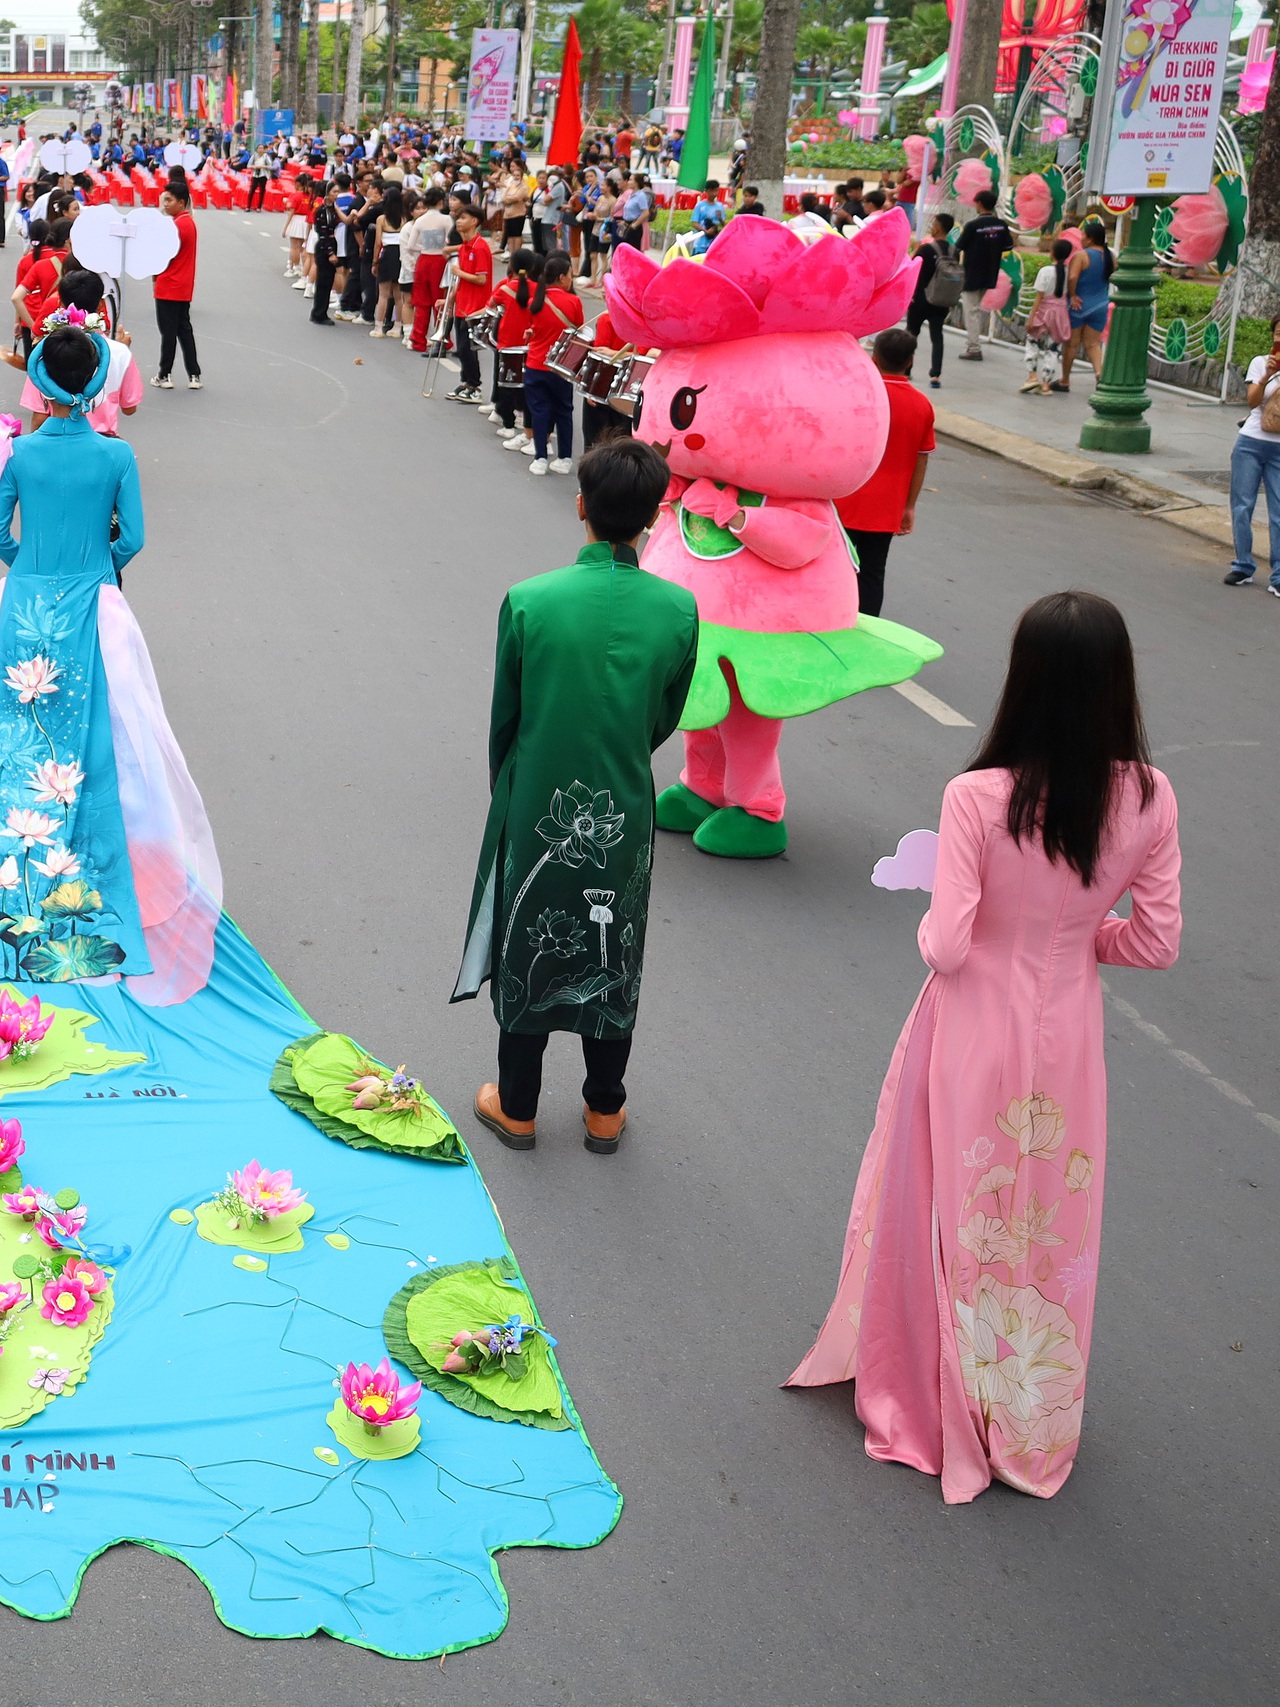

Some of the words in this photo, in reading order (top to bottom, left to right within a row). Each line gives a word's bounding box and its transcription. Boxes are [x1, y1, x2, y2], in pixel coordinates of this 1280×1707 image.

[1168, 41, 1218, 55] TREKKING
[1184, 83, 1212, 102] SEN
[1185, 106, 1209, 118] CHIM
[1155, 131, 1166, 139] GIA
[1188, 130, 1206, 138] CHIM
